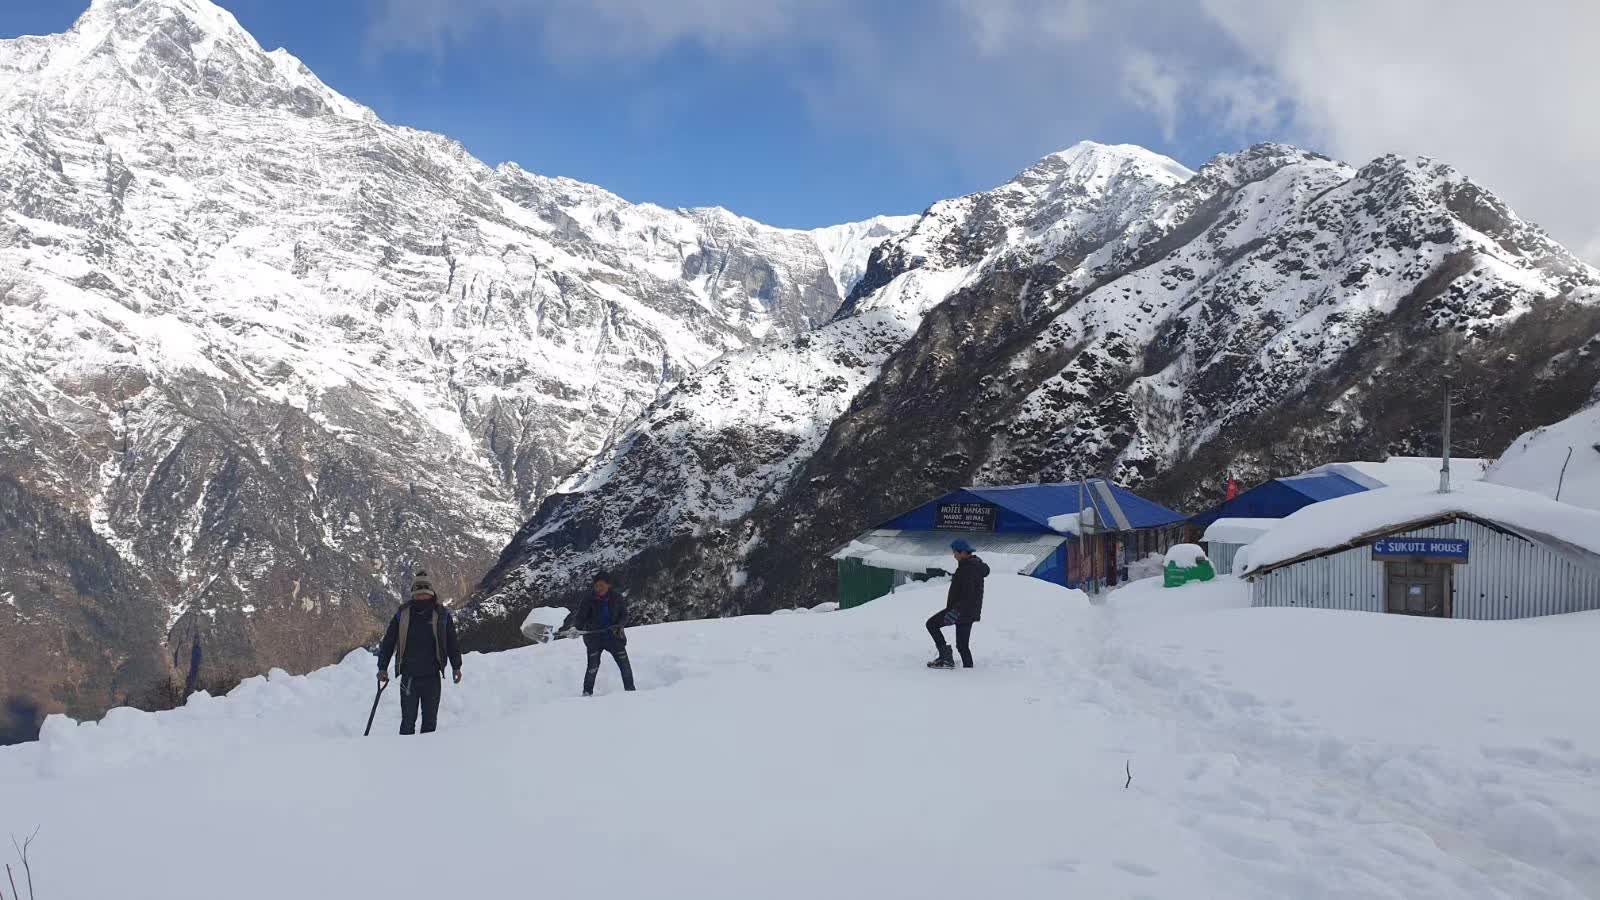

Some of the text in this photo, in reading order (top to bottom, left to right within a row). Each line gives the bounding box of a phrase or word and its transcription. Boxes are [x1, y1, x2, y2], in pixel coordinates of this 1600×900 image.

[941, 506, 961, 514] HOTEL
[1388, 542, 1426, 552] SUKUTI
[1430, 543, 1463, 553] HOUSE
